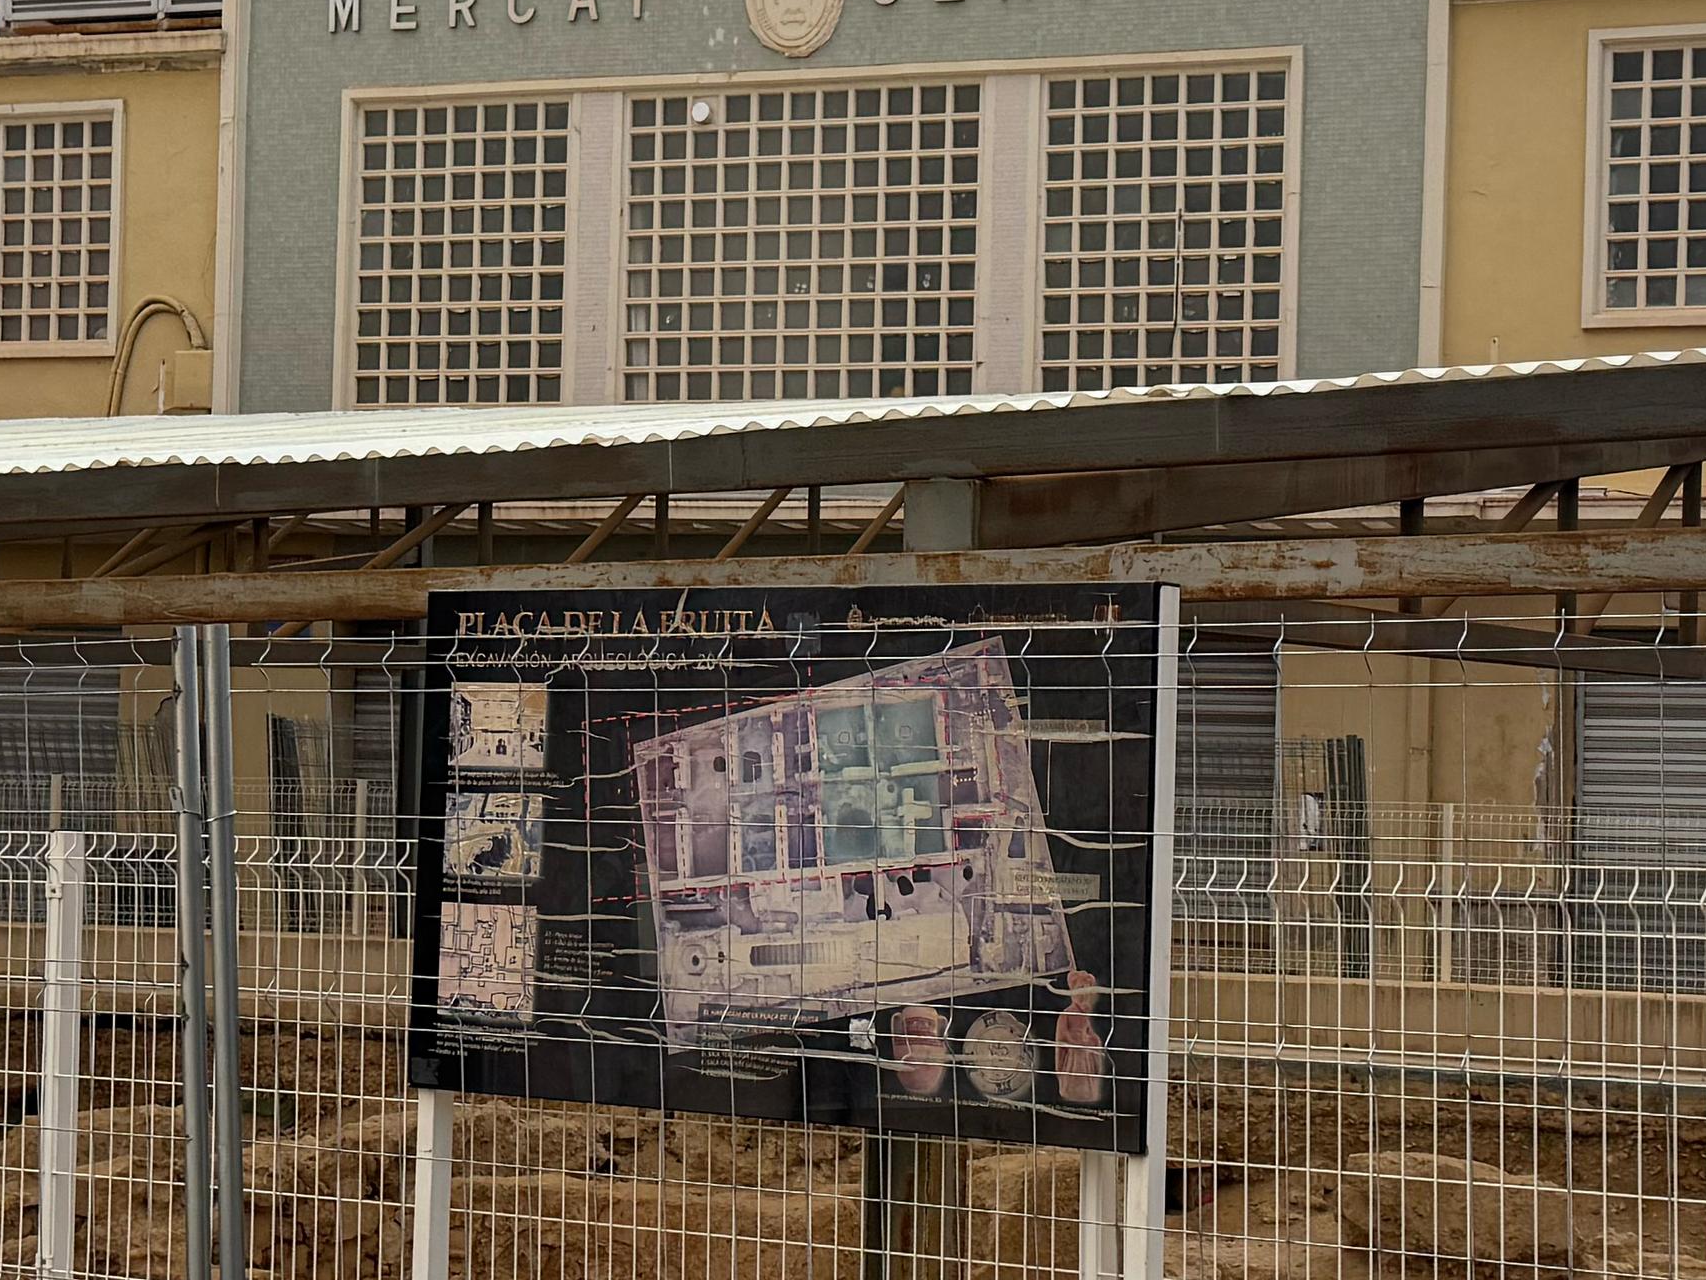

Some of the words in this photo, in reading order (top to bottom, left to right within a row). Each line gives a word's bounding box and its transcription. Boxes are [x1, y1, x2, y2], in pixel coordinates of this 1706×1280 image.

[457, 611, 556, 643] PLAÇA
[564, 610, 604, 638] DE
[611, 609, 649, 637] LA
[659, 609, 775, 638] FRUITA
